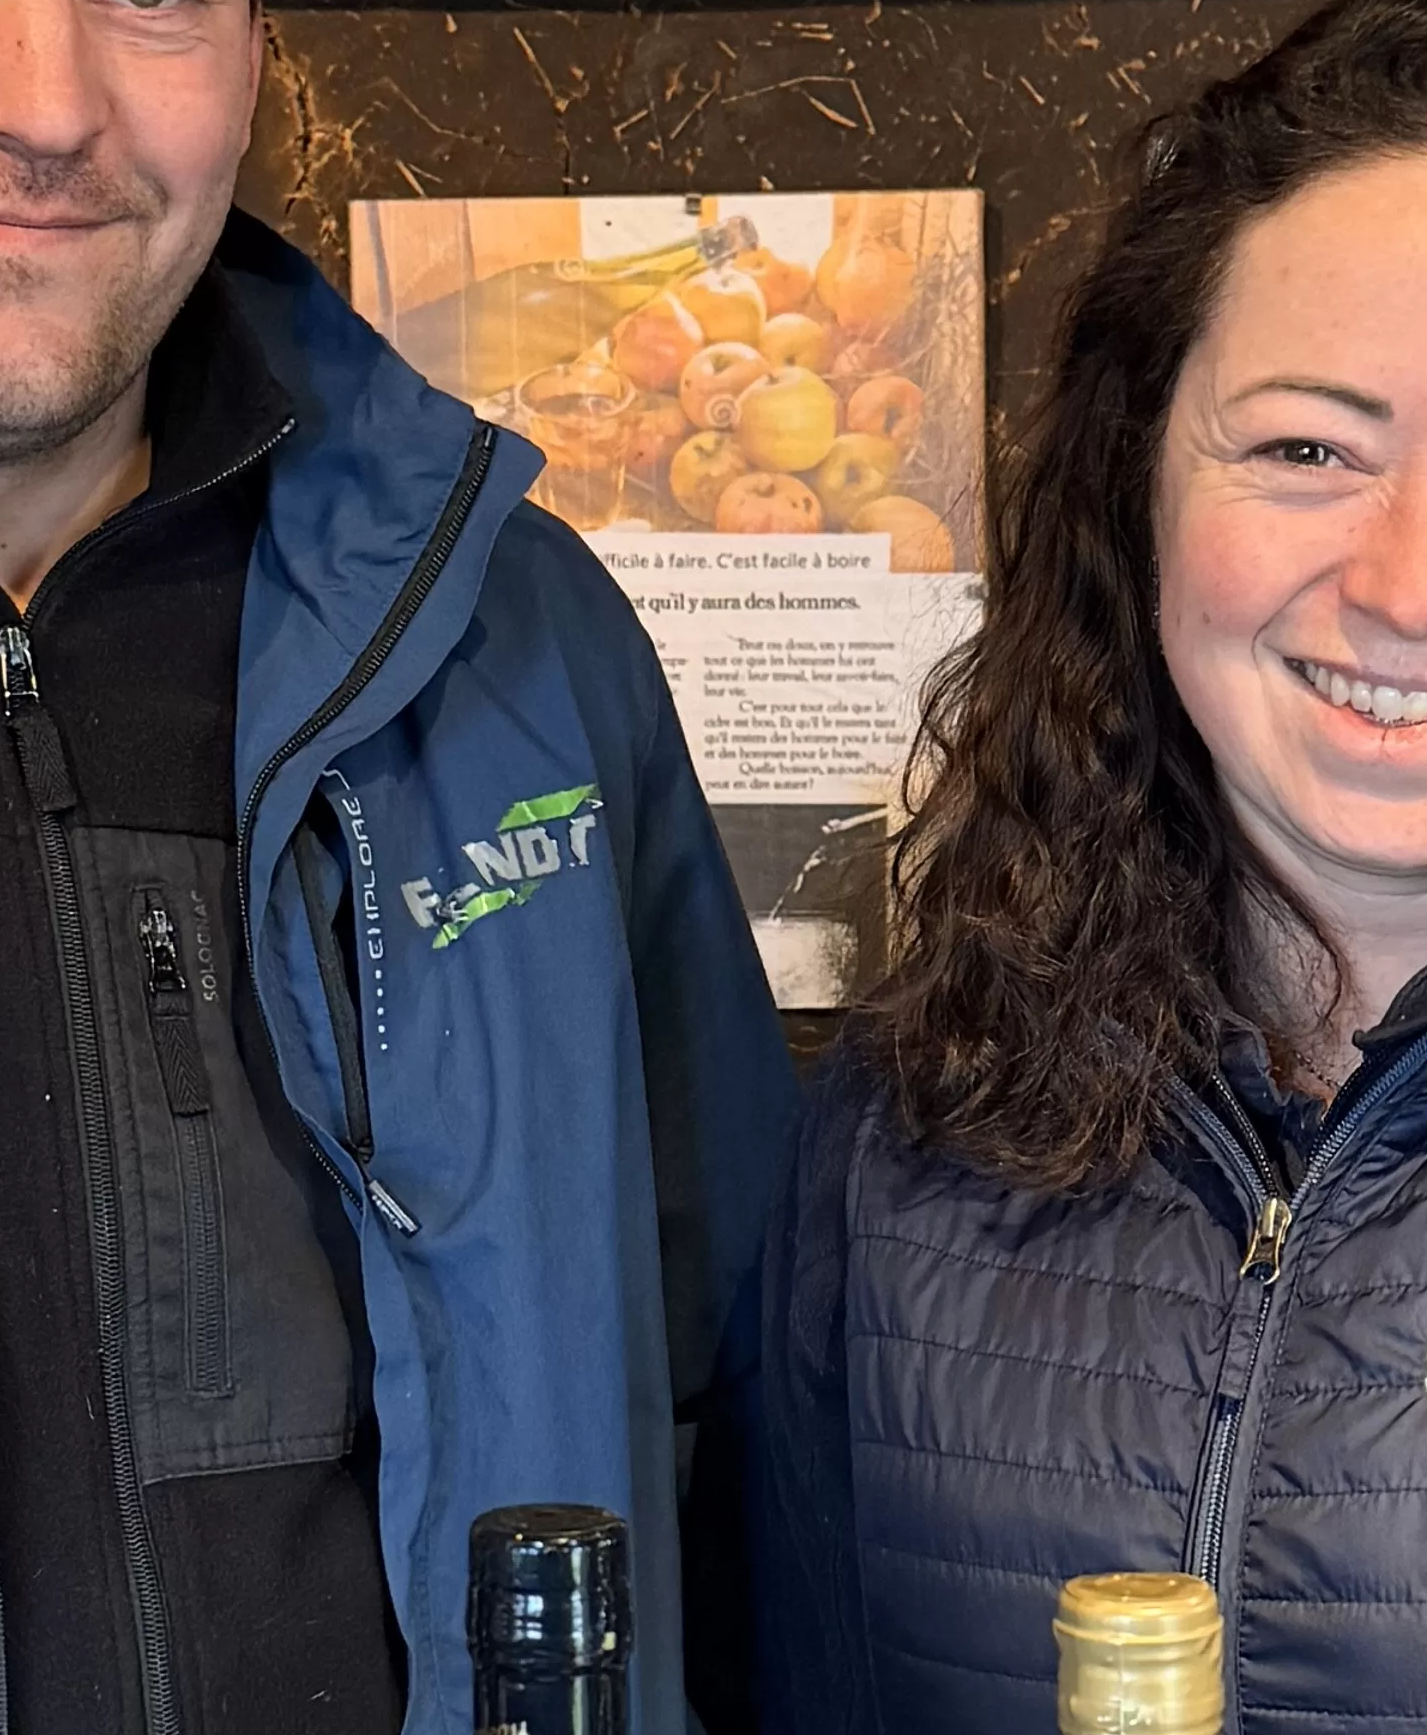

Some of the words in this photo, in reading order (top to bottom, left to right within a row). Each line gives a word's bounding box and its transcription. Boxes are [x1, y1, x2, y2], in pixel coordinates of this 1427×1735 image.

[653, 552, 664, 569] à
[668, 552, 713, 569] faire.
[716, 552, 758, 569] C'est
[763, 552, 808, 569] facile
[812, 551, 823, 569] à
[826, 552, 871, 568] boire
[648, 593, 685, 613] qu'il
[687, 596, 698, 613] y
[701, 596, 741, 610] aura
[744, 593, 775, 610] des
[779, 592, 861, 610] hommes.
